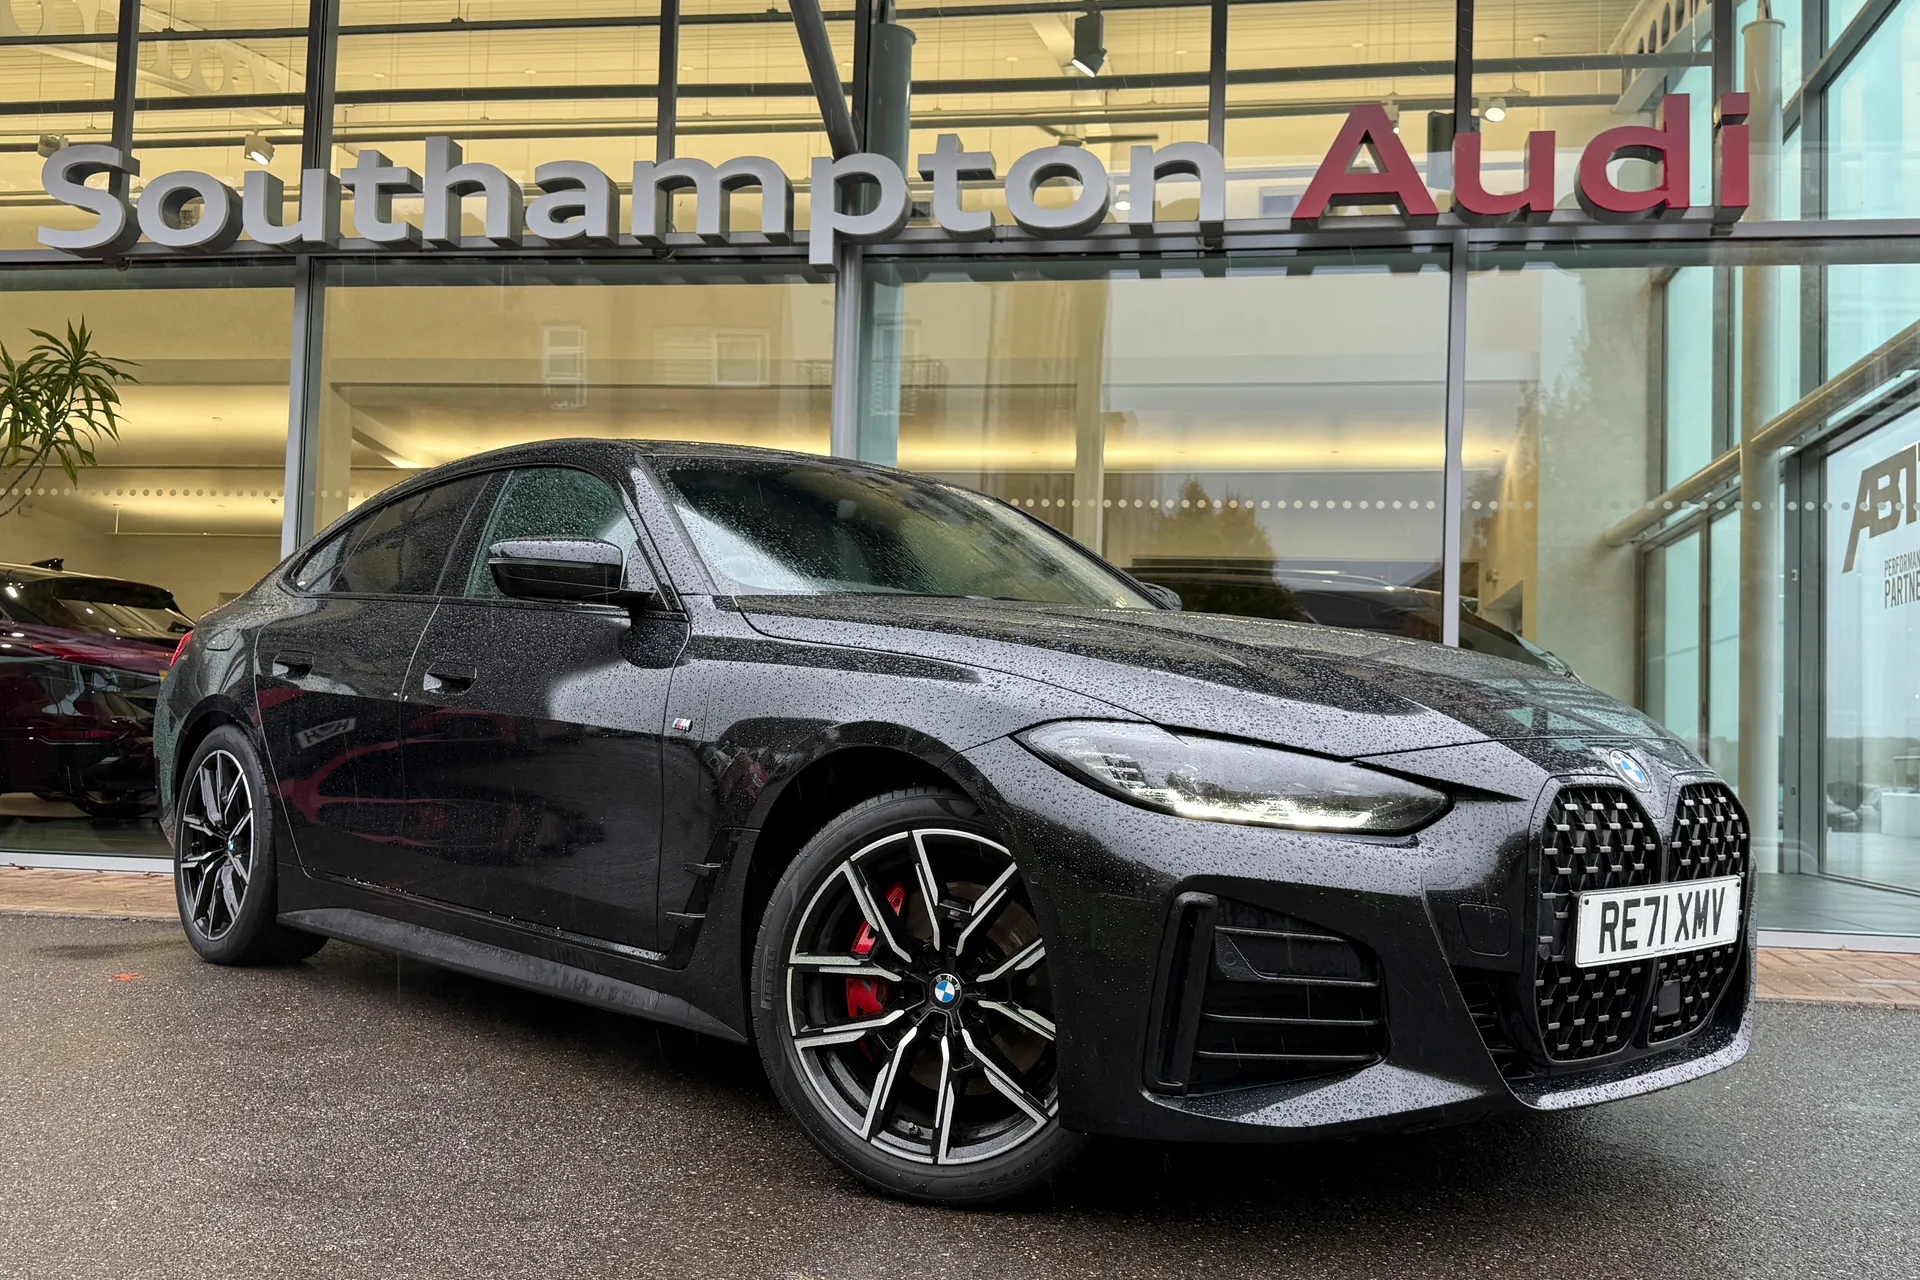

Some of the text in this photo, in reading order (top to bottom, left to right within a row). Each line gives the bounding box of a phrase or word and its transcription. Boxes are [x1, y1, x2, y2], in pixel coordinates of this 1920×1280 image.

[38, 92, 1750, 267] Southampton Audi
[1599, 887, 1725, 953] RE71 XMV
